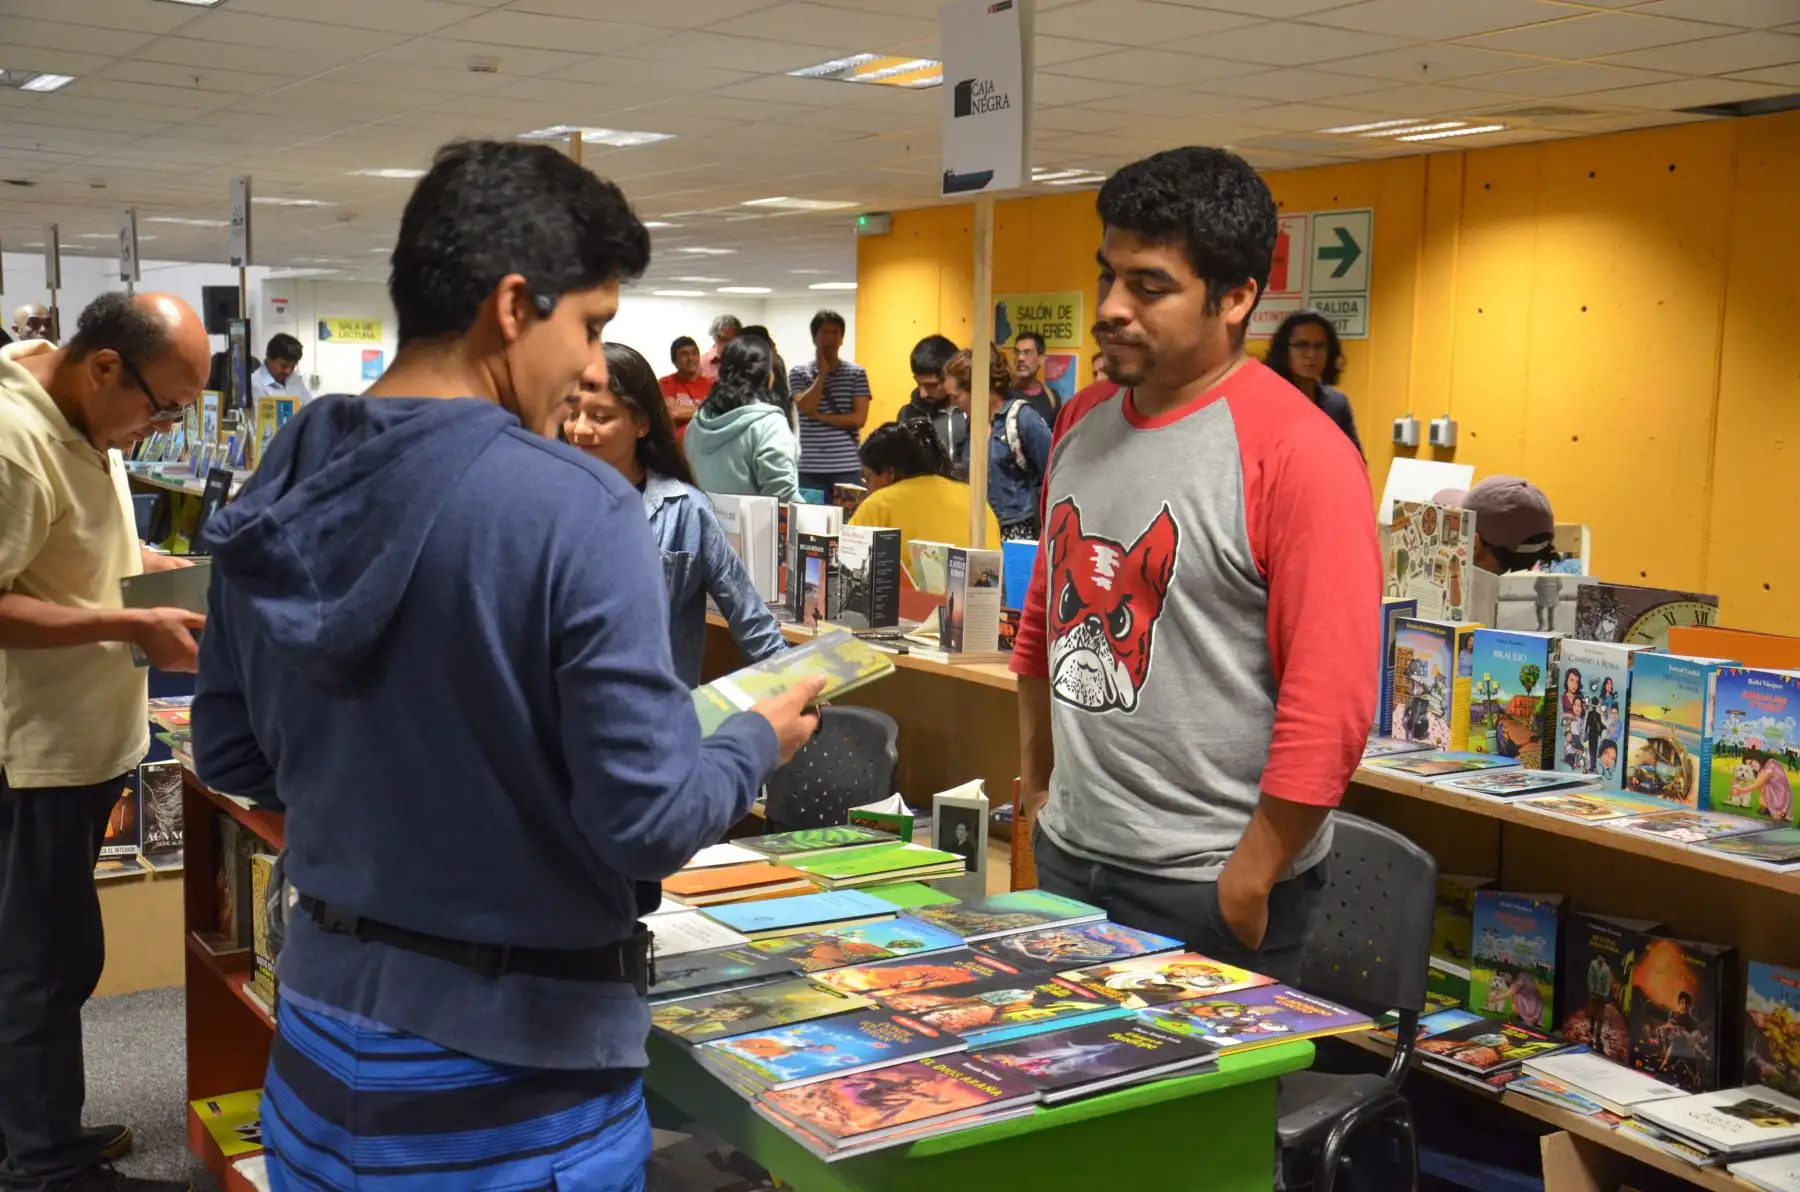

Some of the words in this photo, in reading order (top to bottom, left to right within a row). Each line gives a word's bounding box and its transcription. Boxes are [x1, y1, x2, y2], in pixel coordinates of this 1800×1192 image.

[971, 80, 995, 97] CAJA
[971, 94, 1010, 116] NEGRA
[1017, 302, 1052, 321] SALÓN
[1057, 305, 1073, 320] DE
[1315, 302, 1358, 314] SALIDA
[114, 846, 137, 854] INTERIOR
[919, 1056, 936, 1067] EL
[932, 1063, 964, 1079] DIOS
[960, 1076, 1003, 1097] ARAÑA
